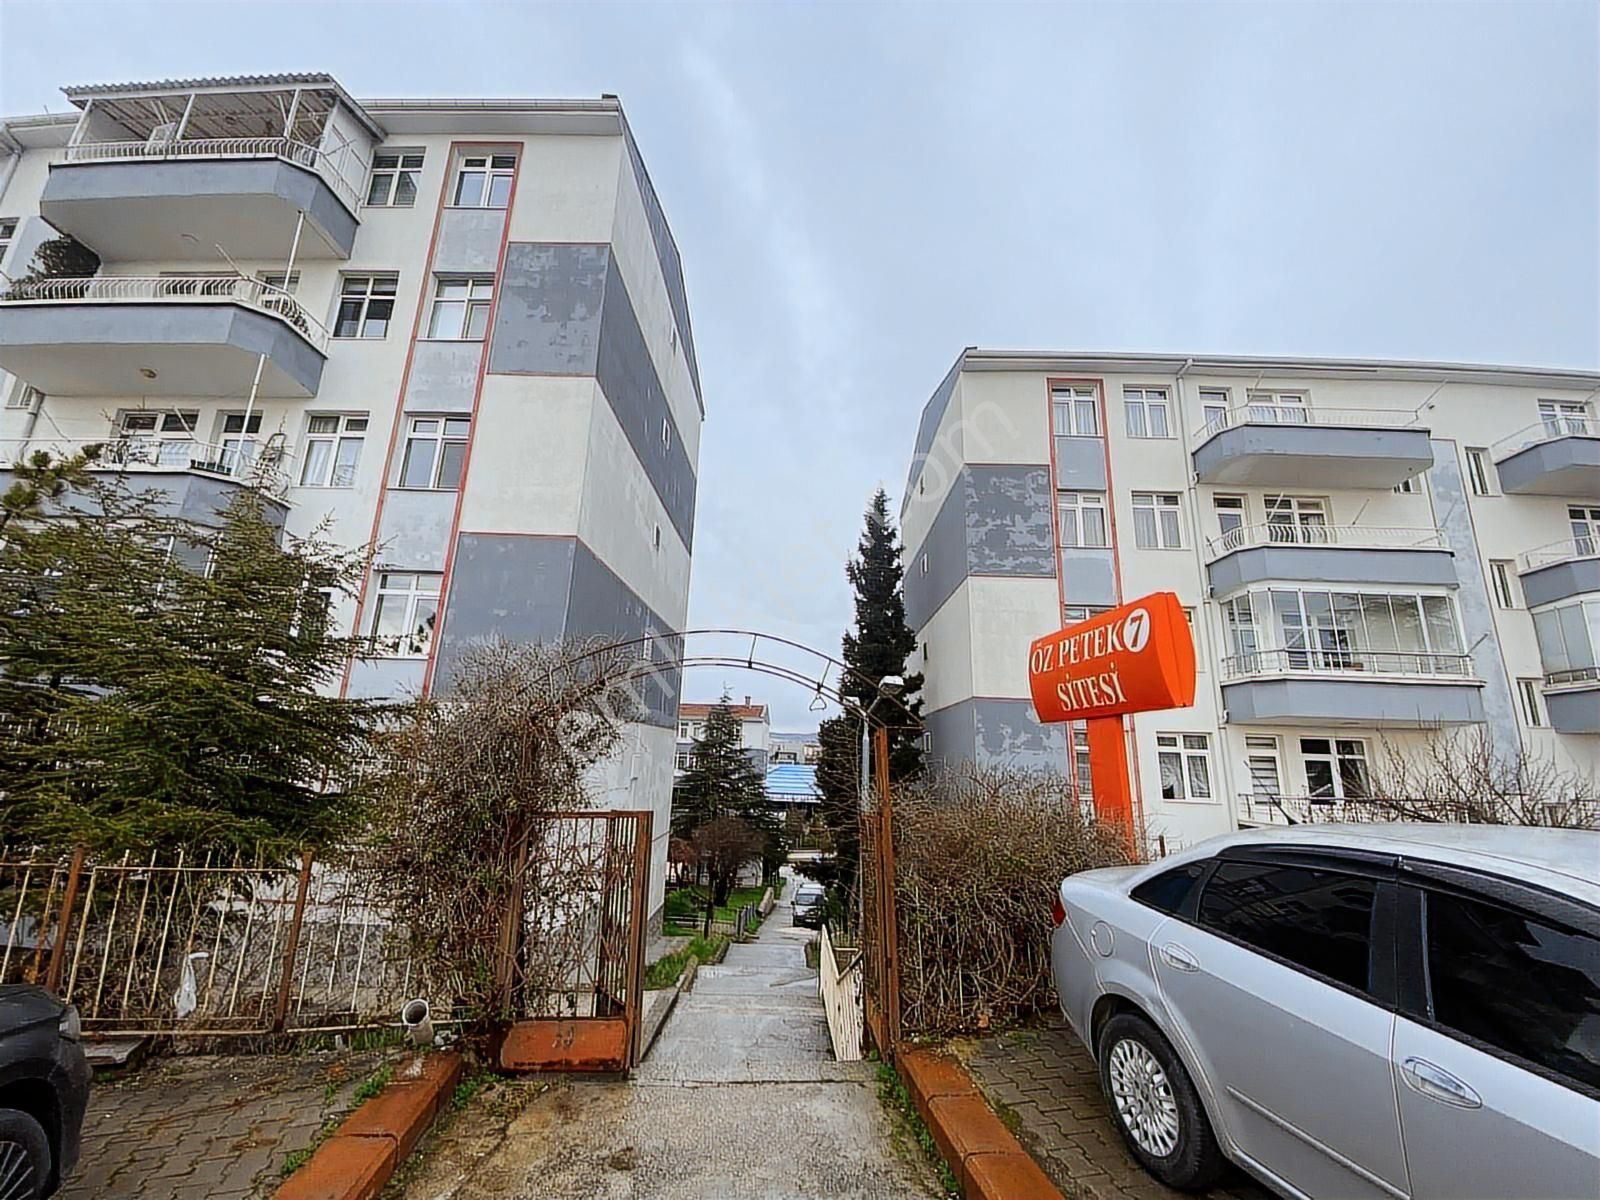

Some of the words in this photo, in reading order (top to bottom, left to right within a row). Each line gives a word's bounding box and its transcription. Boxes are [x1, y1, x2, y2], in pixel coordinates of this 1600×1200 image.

[1031, 643, 1054, 675] ÖZ
[1058, 619, 1124, 668] PETEK
[1129, 613, 1144, 649] 7
[1057, 661, 1127, 712] SİTESİ
